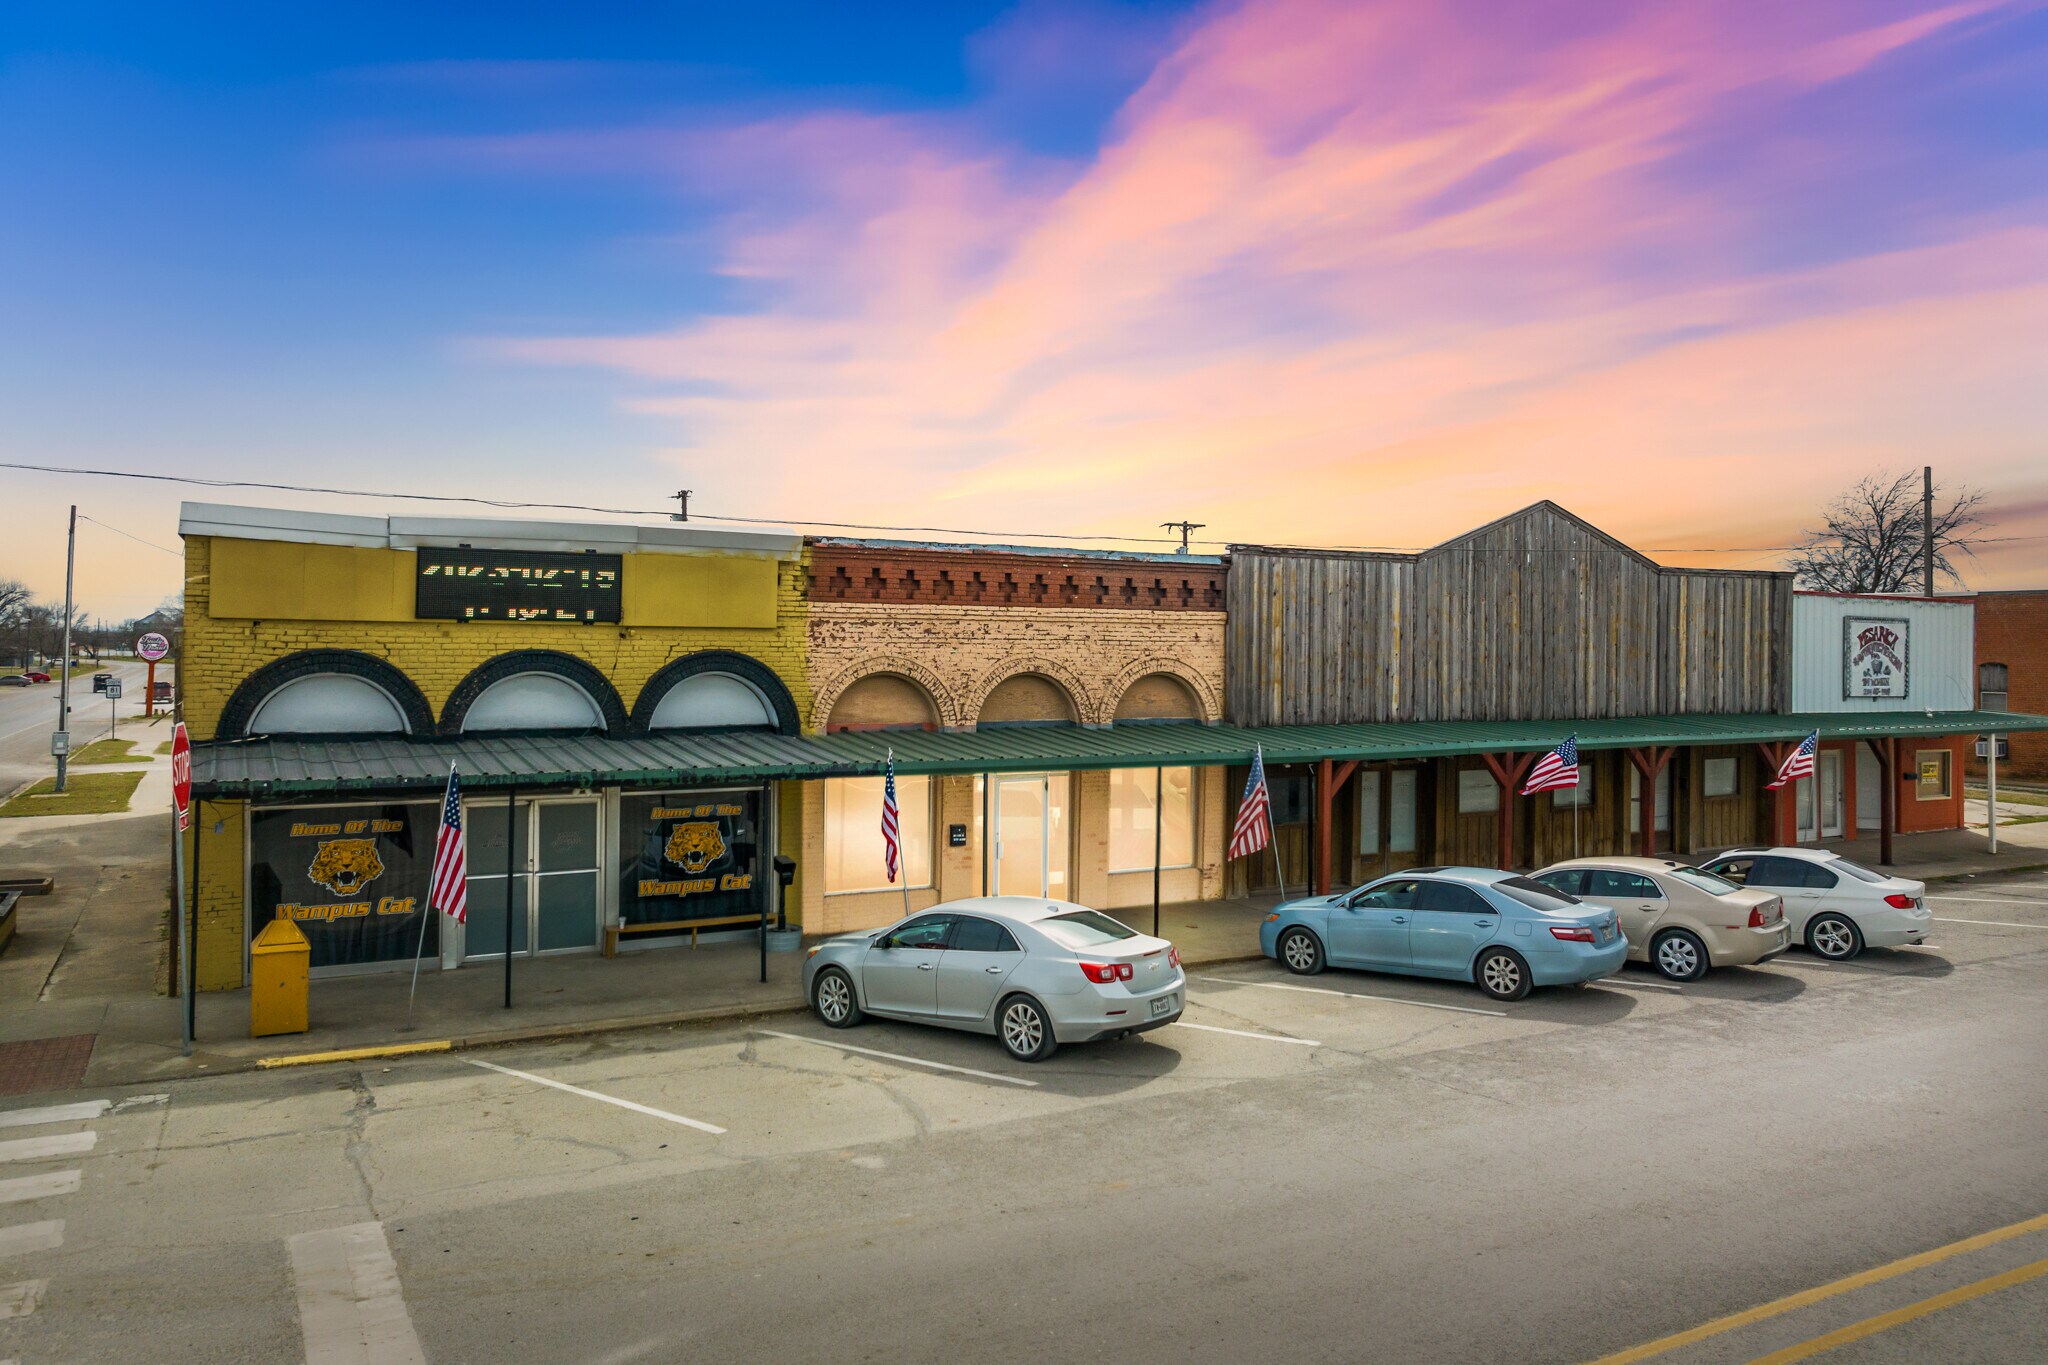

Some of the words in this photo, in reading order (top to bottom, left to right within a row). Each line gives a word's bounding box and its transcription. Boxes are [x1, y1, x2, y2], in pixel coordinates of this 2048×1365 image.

[174, 750, 190, 786] STOP
[651, 807, 692, 820] Home
[694, 805, 714, 817] Of
[717, 804, 742, 816] The
[290, 823, 341, 837] Home
[344, 820, 368, 834] Of
[372, 819, 403, 832] The
[638, 879, 716, 897] Wampus
[720, 874, 752, 890] Cat
[276, 902, 371, 922] Wampus
[377, 897, 416, 914] Cat
